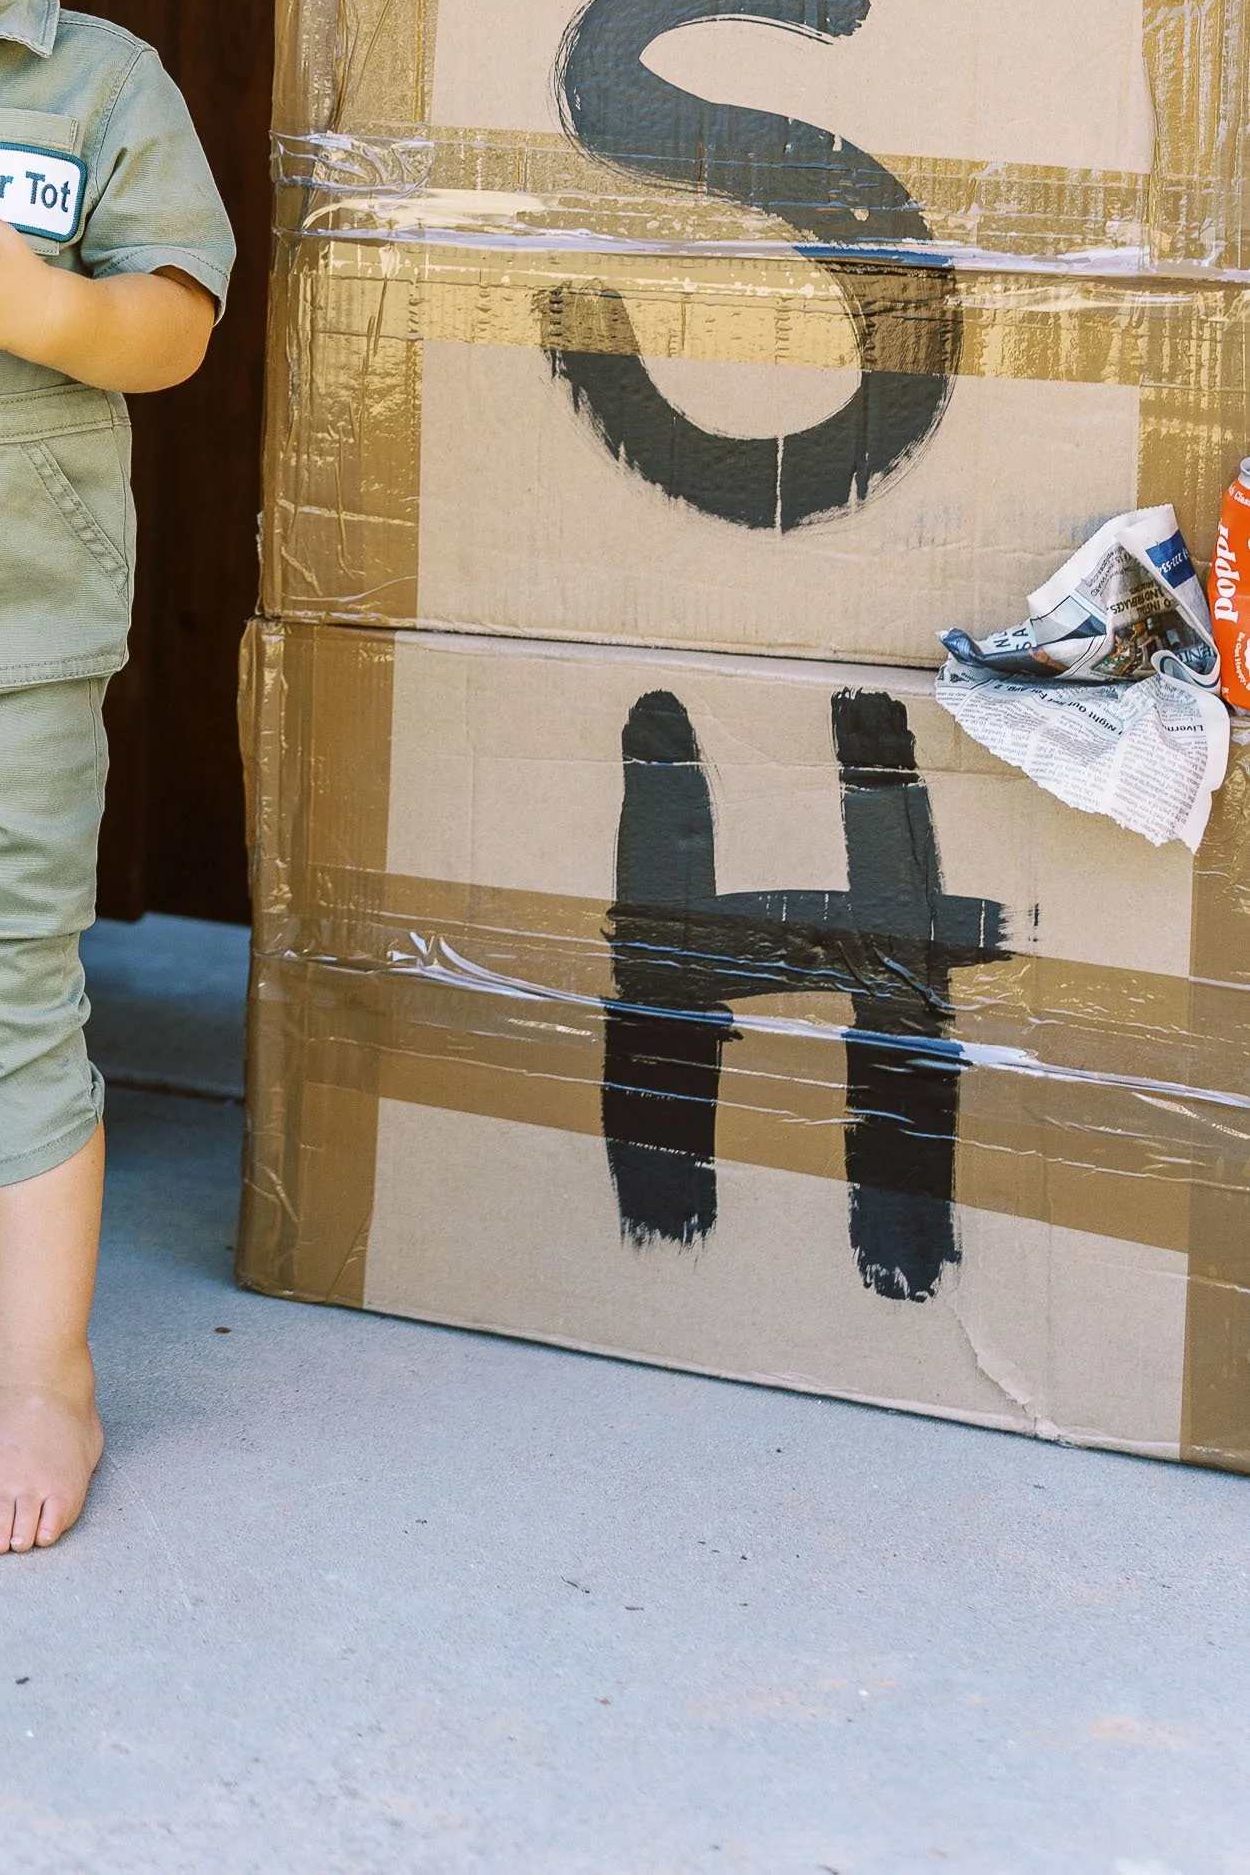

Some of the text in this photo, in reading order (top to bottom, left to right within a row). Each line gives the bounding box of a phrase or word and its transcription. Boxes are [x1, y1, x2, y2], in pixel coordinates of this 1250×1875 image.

[25, 170, 71, 213] Tot
[1069, 701, 1087, 713] Out
[1088, 712, 1117, 734] Night
[600, 687, 1039, 1303] H
